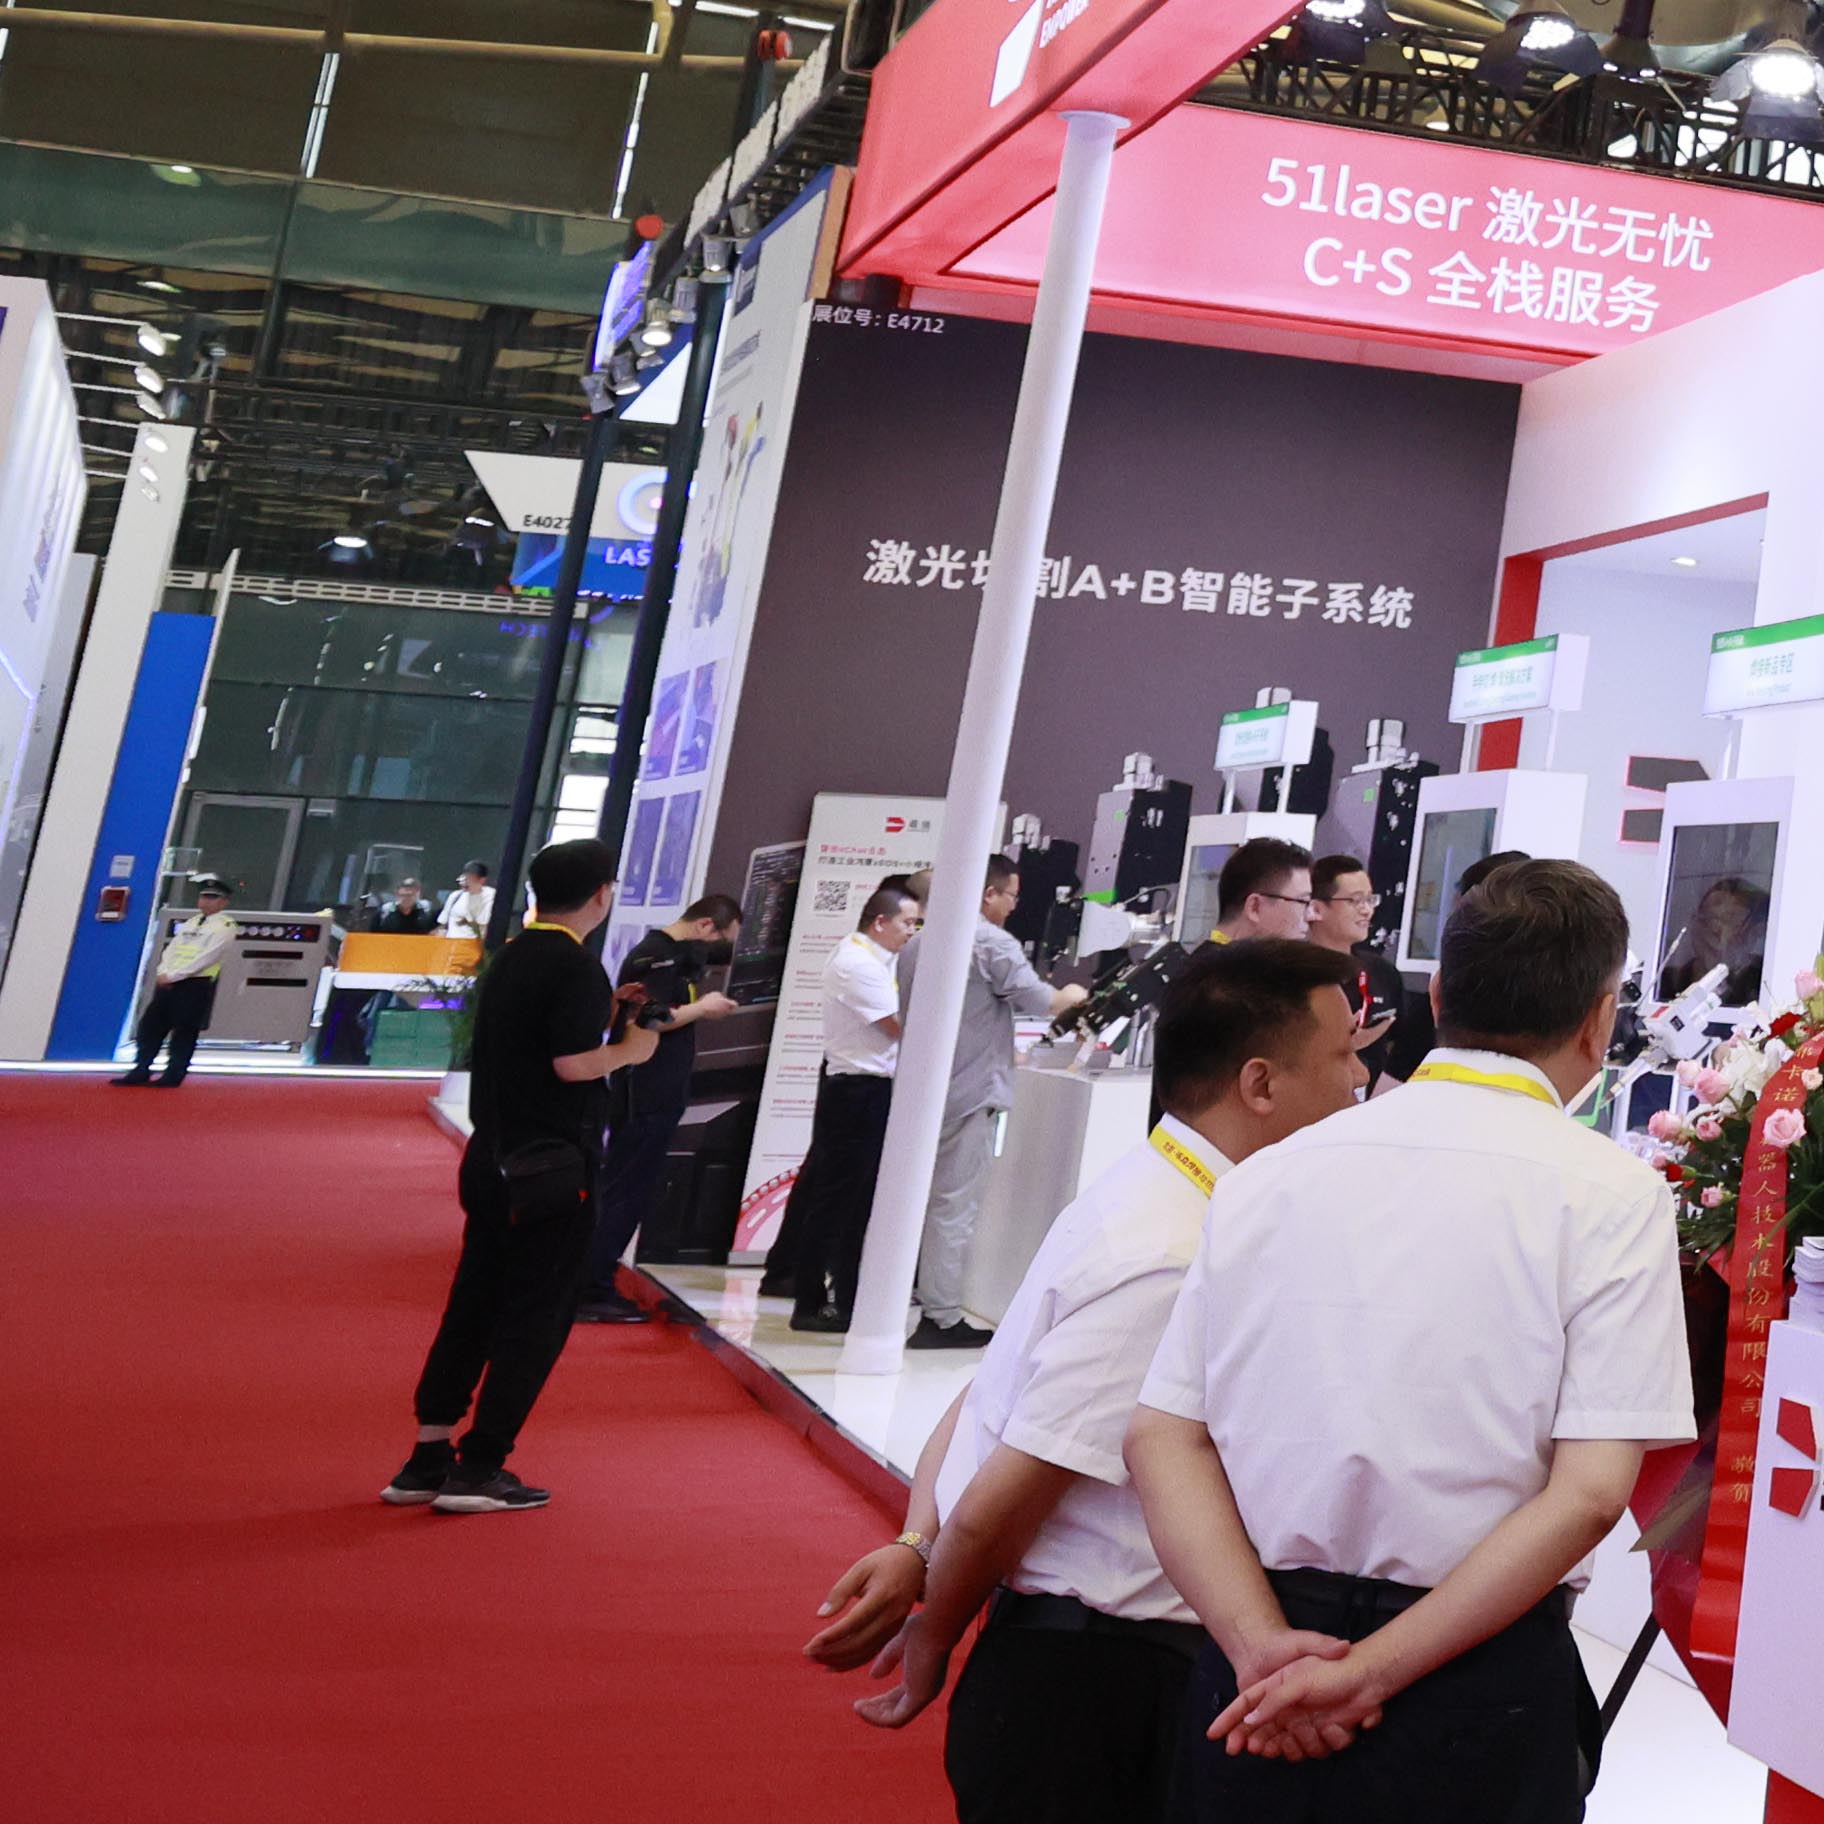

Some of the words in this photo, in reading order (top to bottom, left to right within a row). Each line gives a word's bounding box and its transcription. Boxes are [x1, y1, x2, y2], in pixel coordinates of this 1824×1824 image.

[1261, 156, 1474, 233] 51laser
[1481, 185, 1715, 272] 激光无忧
[1303, 236, 1414, 297] C+S
[1426, 250, 1660, 333] 全栈服务
